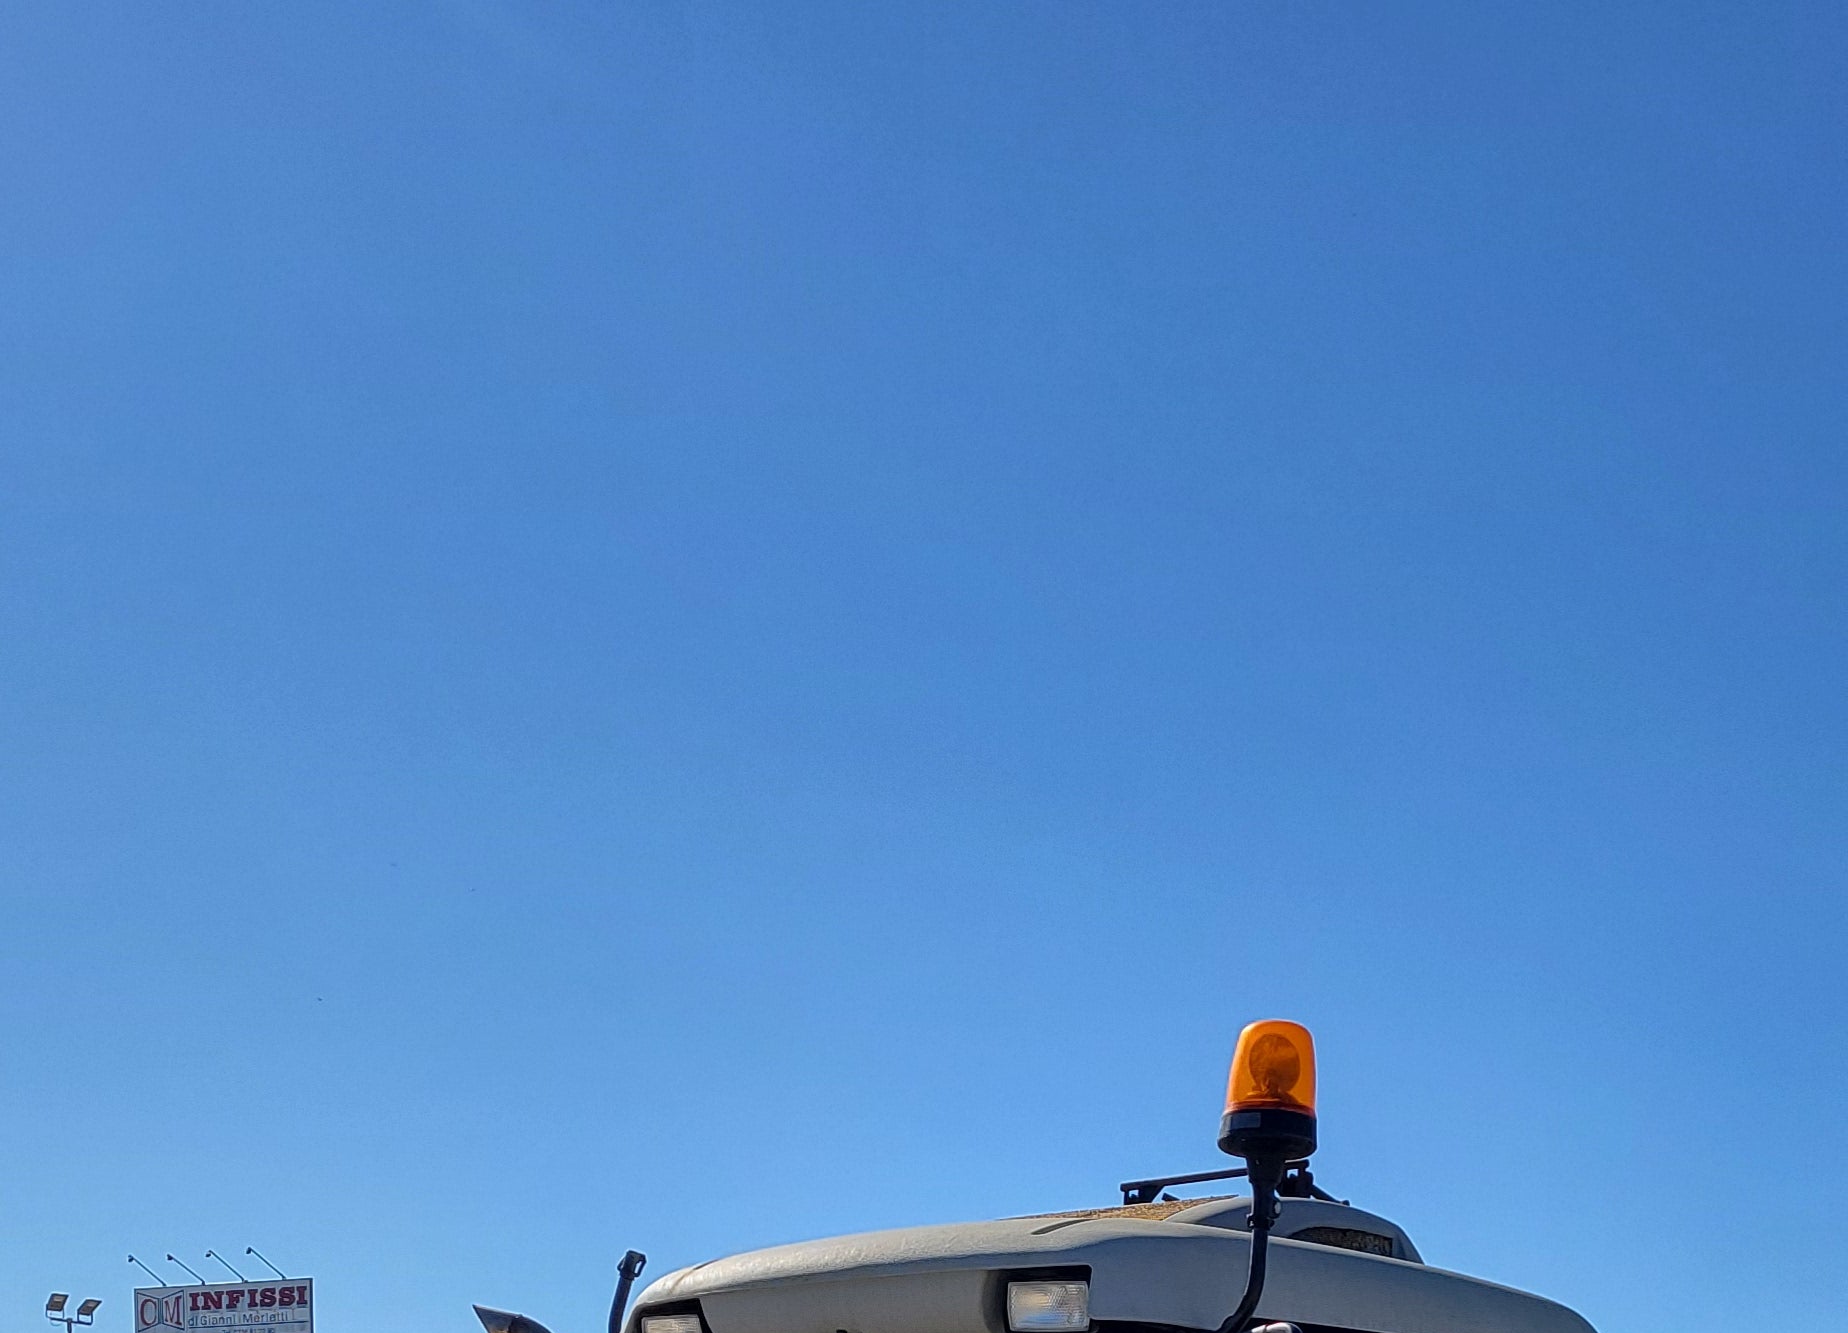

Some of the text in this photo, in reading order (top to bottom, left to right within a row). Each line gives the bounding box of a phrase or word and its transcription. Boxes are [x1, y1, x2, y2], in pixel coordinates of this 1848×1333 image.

[189, 1285, 308, 1311] INFISSI
[200, 1312, 236, 1326] Gianni
[242, 1310, 288, 1323] Merletti
